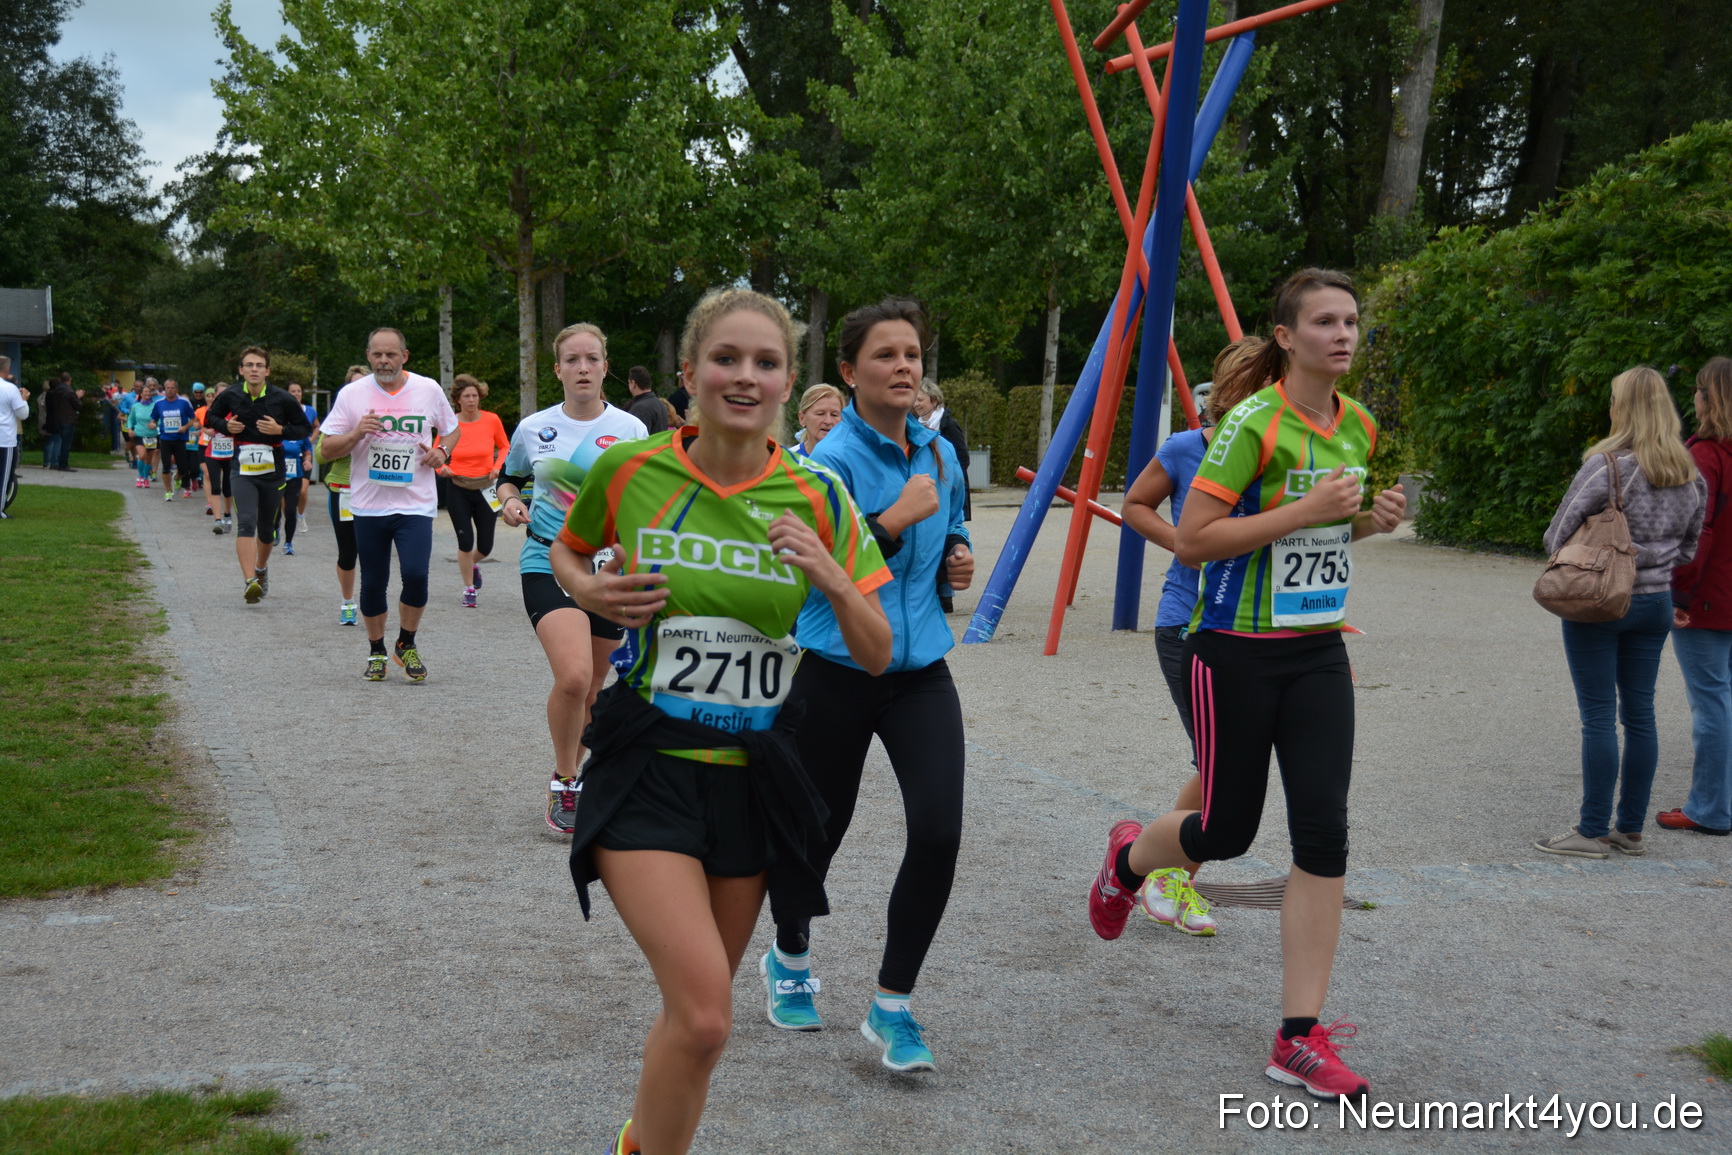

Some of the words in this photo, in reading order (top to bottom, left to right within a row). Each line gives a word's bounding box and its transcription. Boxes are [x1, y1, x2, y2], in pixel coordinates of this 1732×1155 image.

[379, 415, 426, 433] OGT
[1207, 395, 1270, 467] BOCK
[213, 442, 232, 450] 2555
[249, 452, 263, 464] 17
[372, 453, 411, 471] 2667
[377, 473, 404, 481] Joachim
[1275, 537, 1309, 547] PARTL
[637, 528, 797, 585] BOCK
[1283, 549, 1349, 587] 2753
[1300, 595, 1337, 610] Annika
[662, 628, 712, 643] PARTL
[668, 646, 783, 699] 2710
